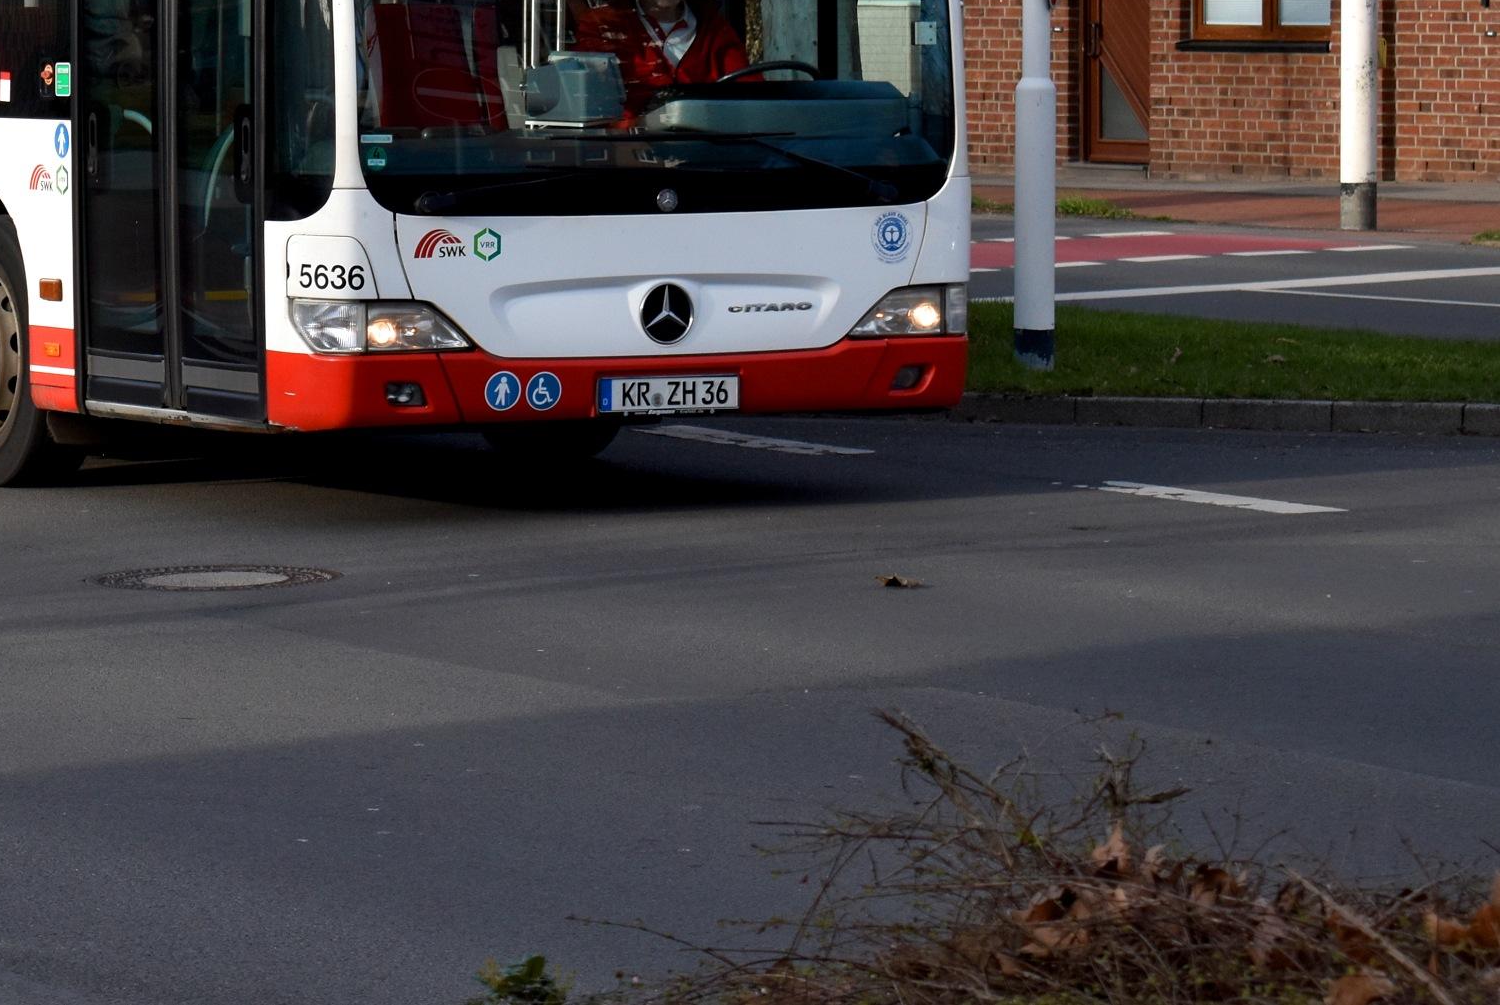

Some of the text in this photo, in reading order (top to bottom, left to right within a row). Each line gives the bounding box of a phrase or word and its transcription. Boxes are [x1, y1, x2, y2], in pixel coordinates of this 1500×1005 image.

[40, 180, 53, 192] SWK
[438, 246, 466, 258] SWK
[299, 264, 365, 290] 5636
[727, 301, 813, 314] CITARO
[622, 380, 728, 406] KR ZH 36
